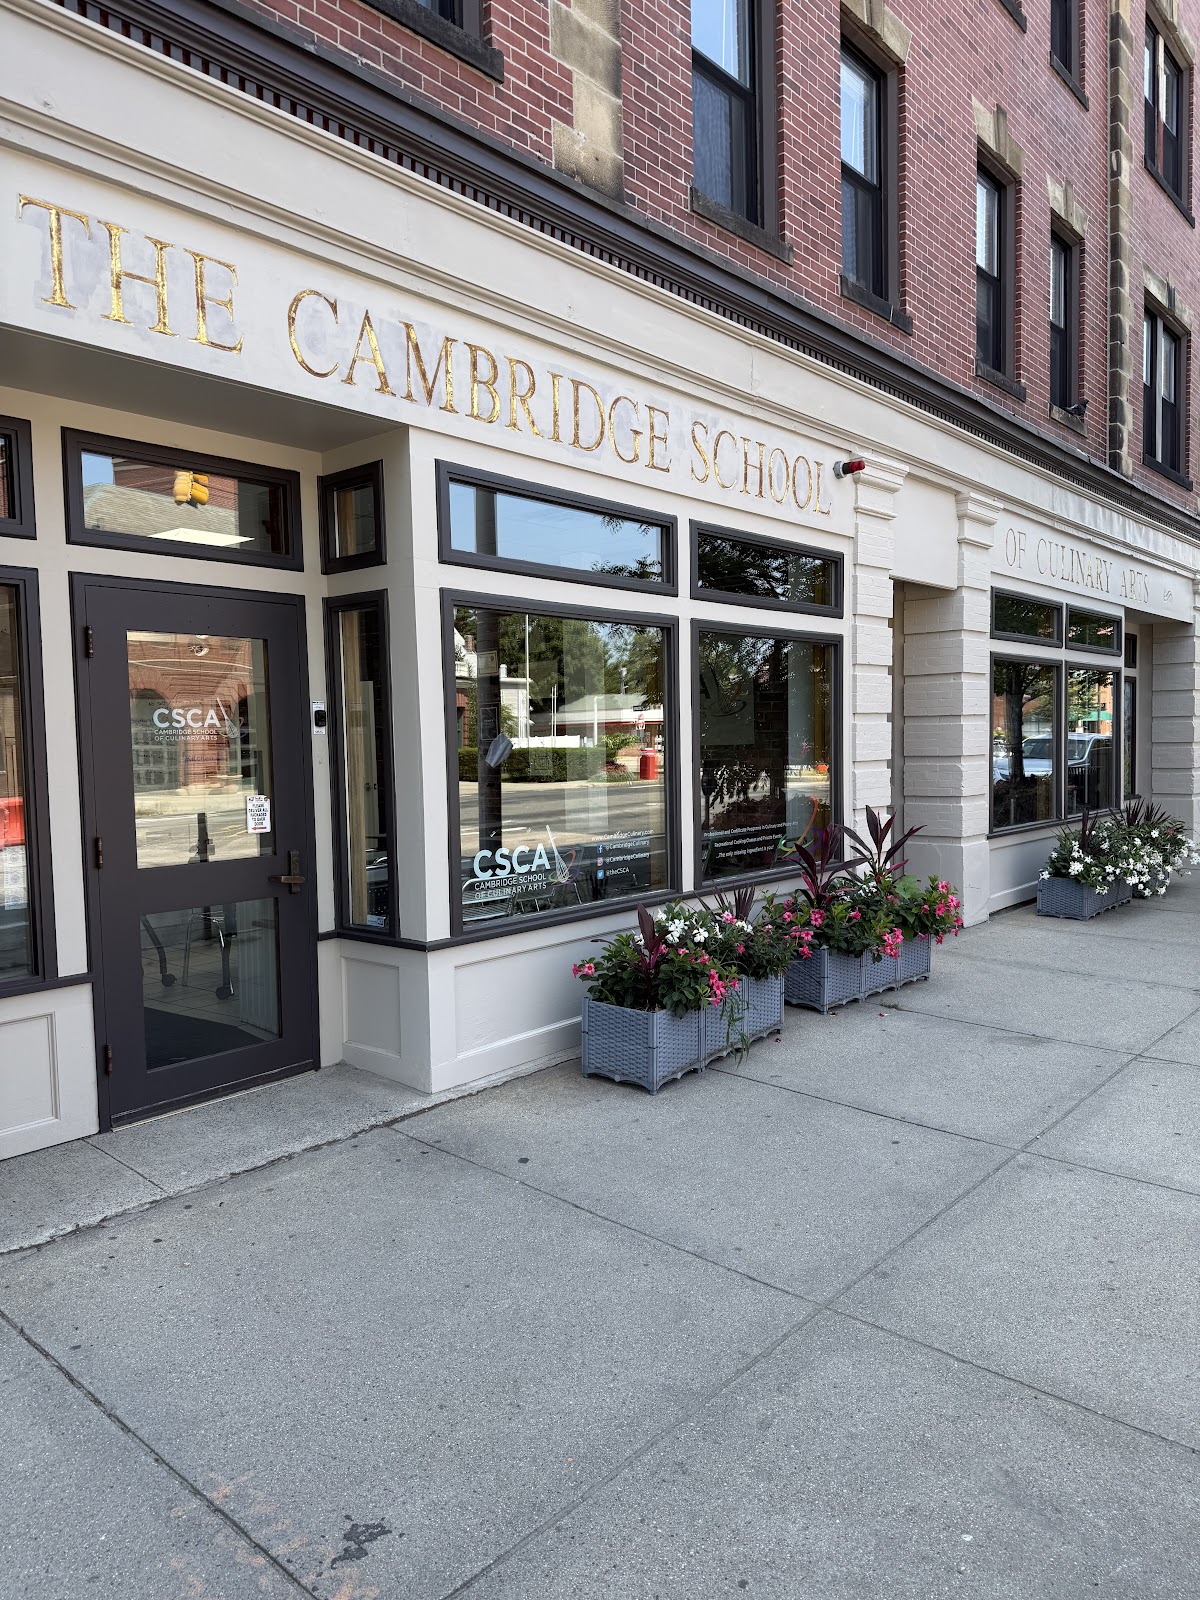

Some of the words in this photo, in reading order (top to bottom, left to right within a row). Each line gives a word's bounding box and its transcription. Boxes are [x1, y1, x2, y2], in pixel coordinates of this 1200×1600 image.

[17, 192, 245, 355] THE
[287, 288, 673, 474] CAMBRIDGE
[690, 420, 832, 516] SCHOOL
[1005, 528, 1027, 570] OF
[1036, 538, 1113, 594] CULINARY
[1119, 567, 1150, 604] ARTS
[152, 708, 221, 728] CSCA
[605, 840, 650, 851] @CambridgeCulinary
[473, 842, 551, 879] CSCA
[605, 852, 650, 864] @CambridgeCulinary
[605, 867, 630, 877] @theCSCA
[474, 876, 518, 891] CAMBRIDGE
[518, 873, 546, 885] SCHOOL
[475, 891, 487, 900] OF
[487, 885, 527, 898] CULINARY
[527, 881, 547, 892] ARTS
